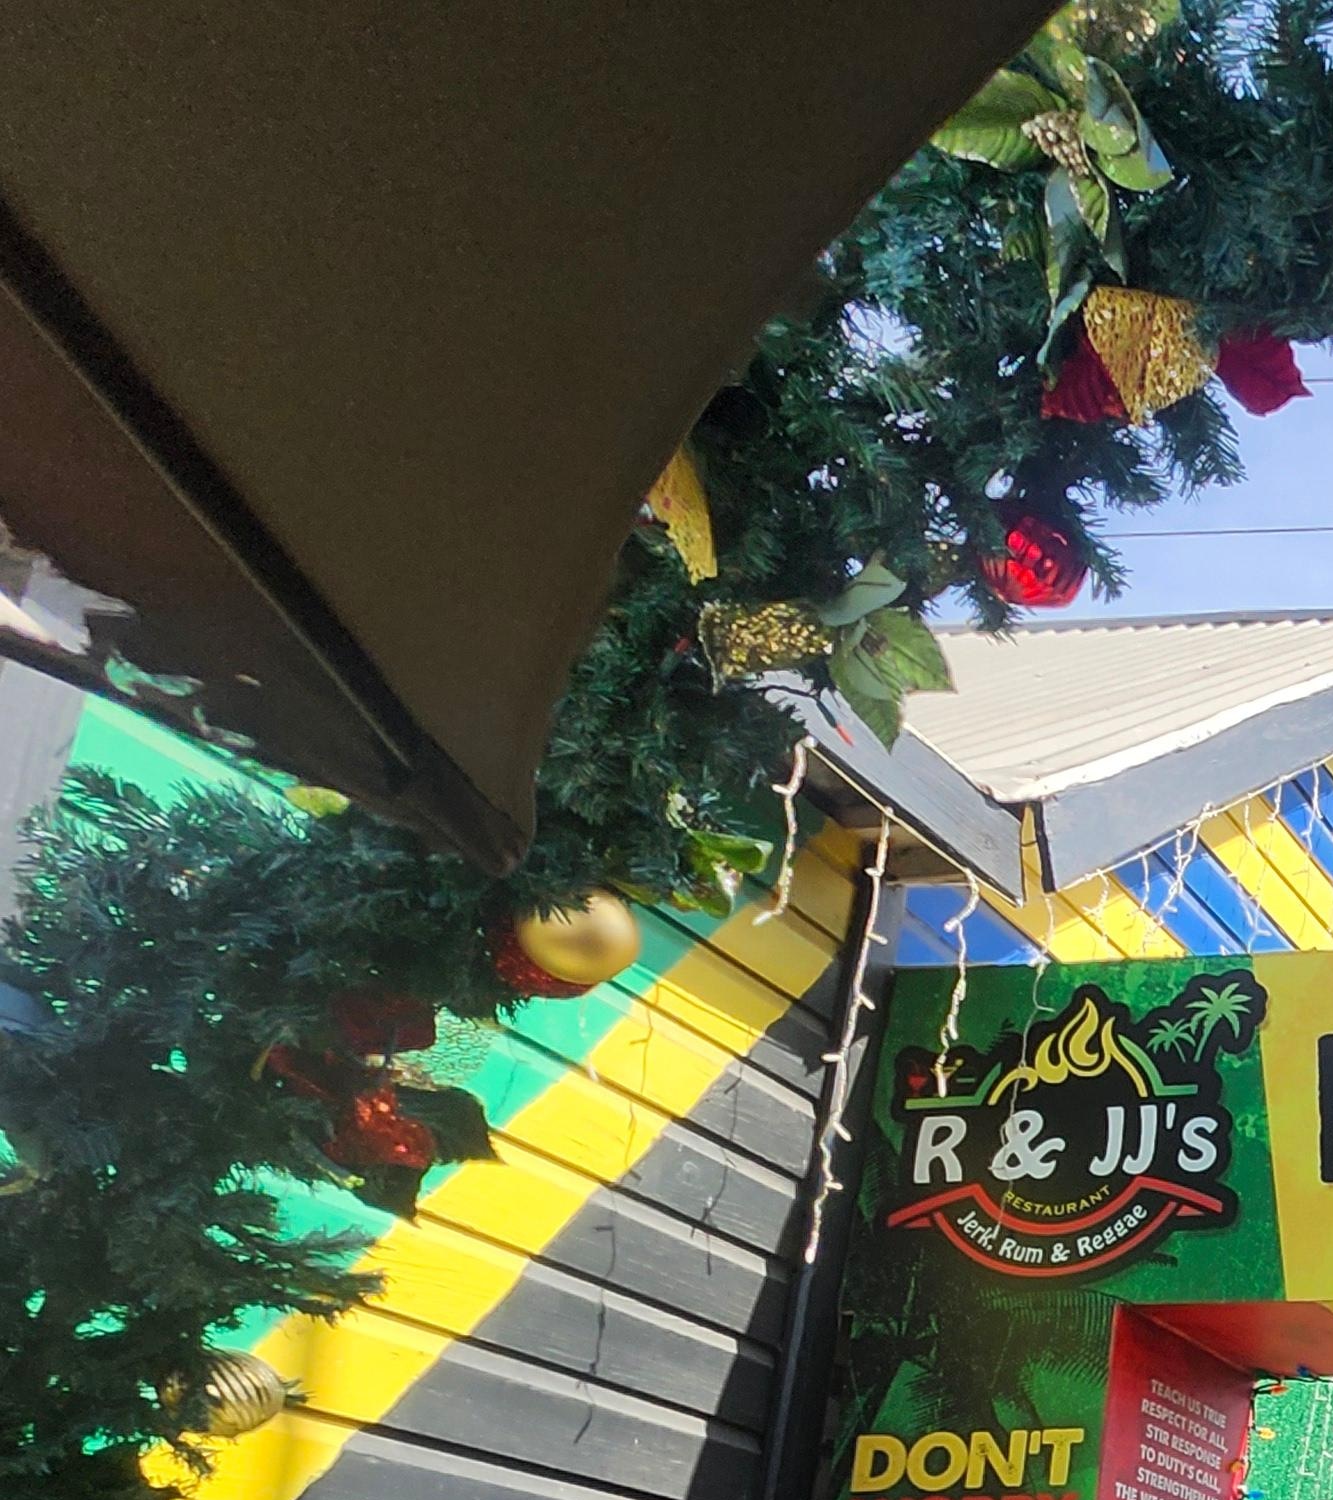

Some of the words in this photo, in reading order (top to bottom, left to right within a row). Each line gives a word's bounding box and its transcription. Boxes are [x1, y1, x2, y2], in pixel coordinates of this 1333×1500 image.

[913, 1114, 968, 1184] R
[992, 1109, 1066, 1180] &
[1088, 1104, 1218, 1177] JJ's
[1002, 1184, 1112, 1217] RESTAURANT
[998, 1237, 1045, 1265] Rum
[1050, 1242, 1070, 1264] &
[1076, 1203, 1149, 1258] Reggae
[1141, 1398, 1188, 1431] RESPECT
[1187, 1420, 1209, 1442] FOR
[1208, 1431, 1229, 1454] ALL,
[1150, 1379, 1187, 1408] TEACH
[1187, 1397, 1201, 1416] US
[1202, 1404, 1228, 1430] TRUE
[850, 1427, 1085, 1493] DON'T
[1140, 1443, 1157, 1463] TO
[1156, 1451, 1196, 1480] DUTY'S
[1195, 1469, 1221, 1495] CALL,
[1145, 1423, 1171, 1447] STIR
[1170, 1434, 1222, 1471] RESPONSE
